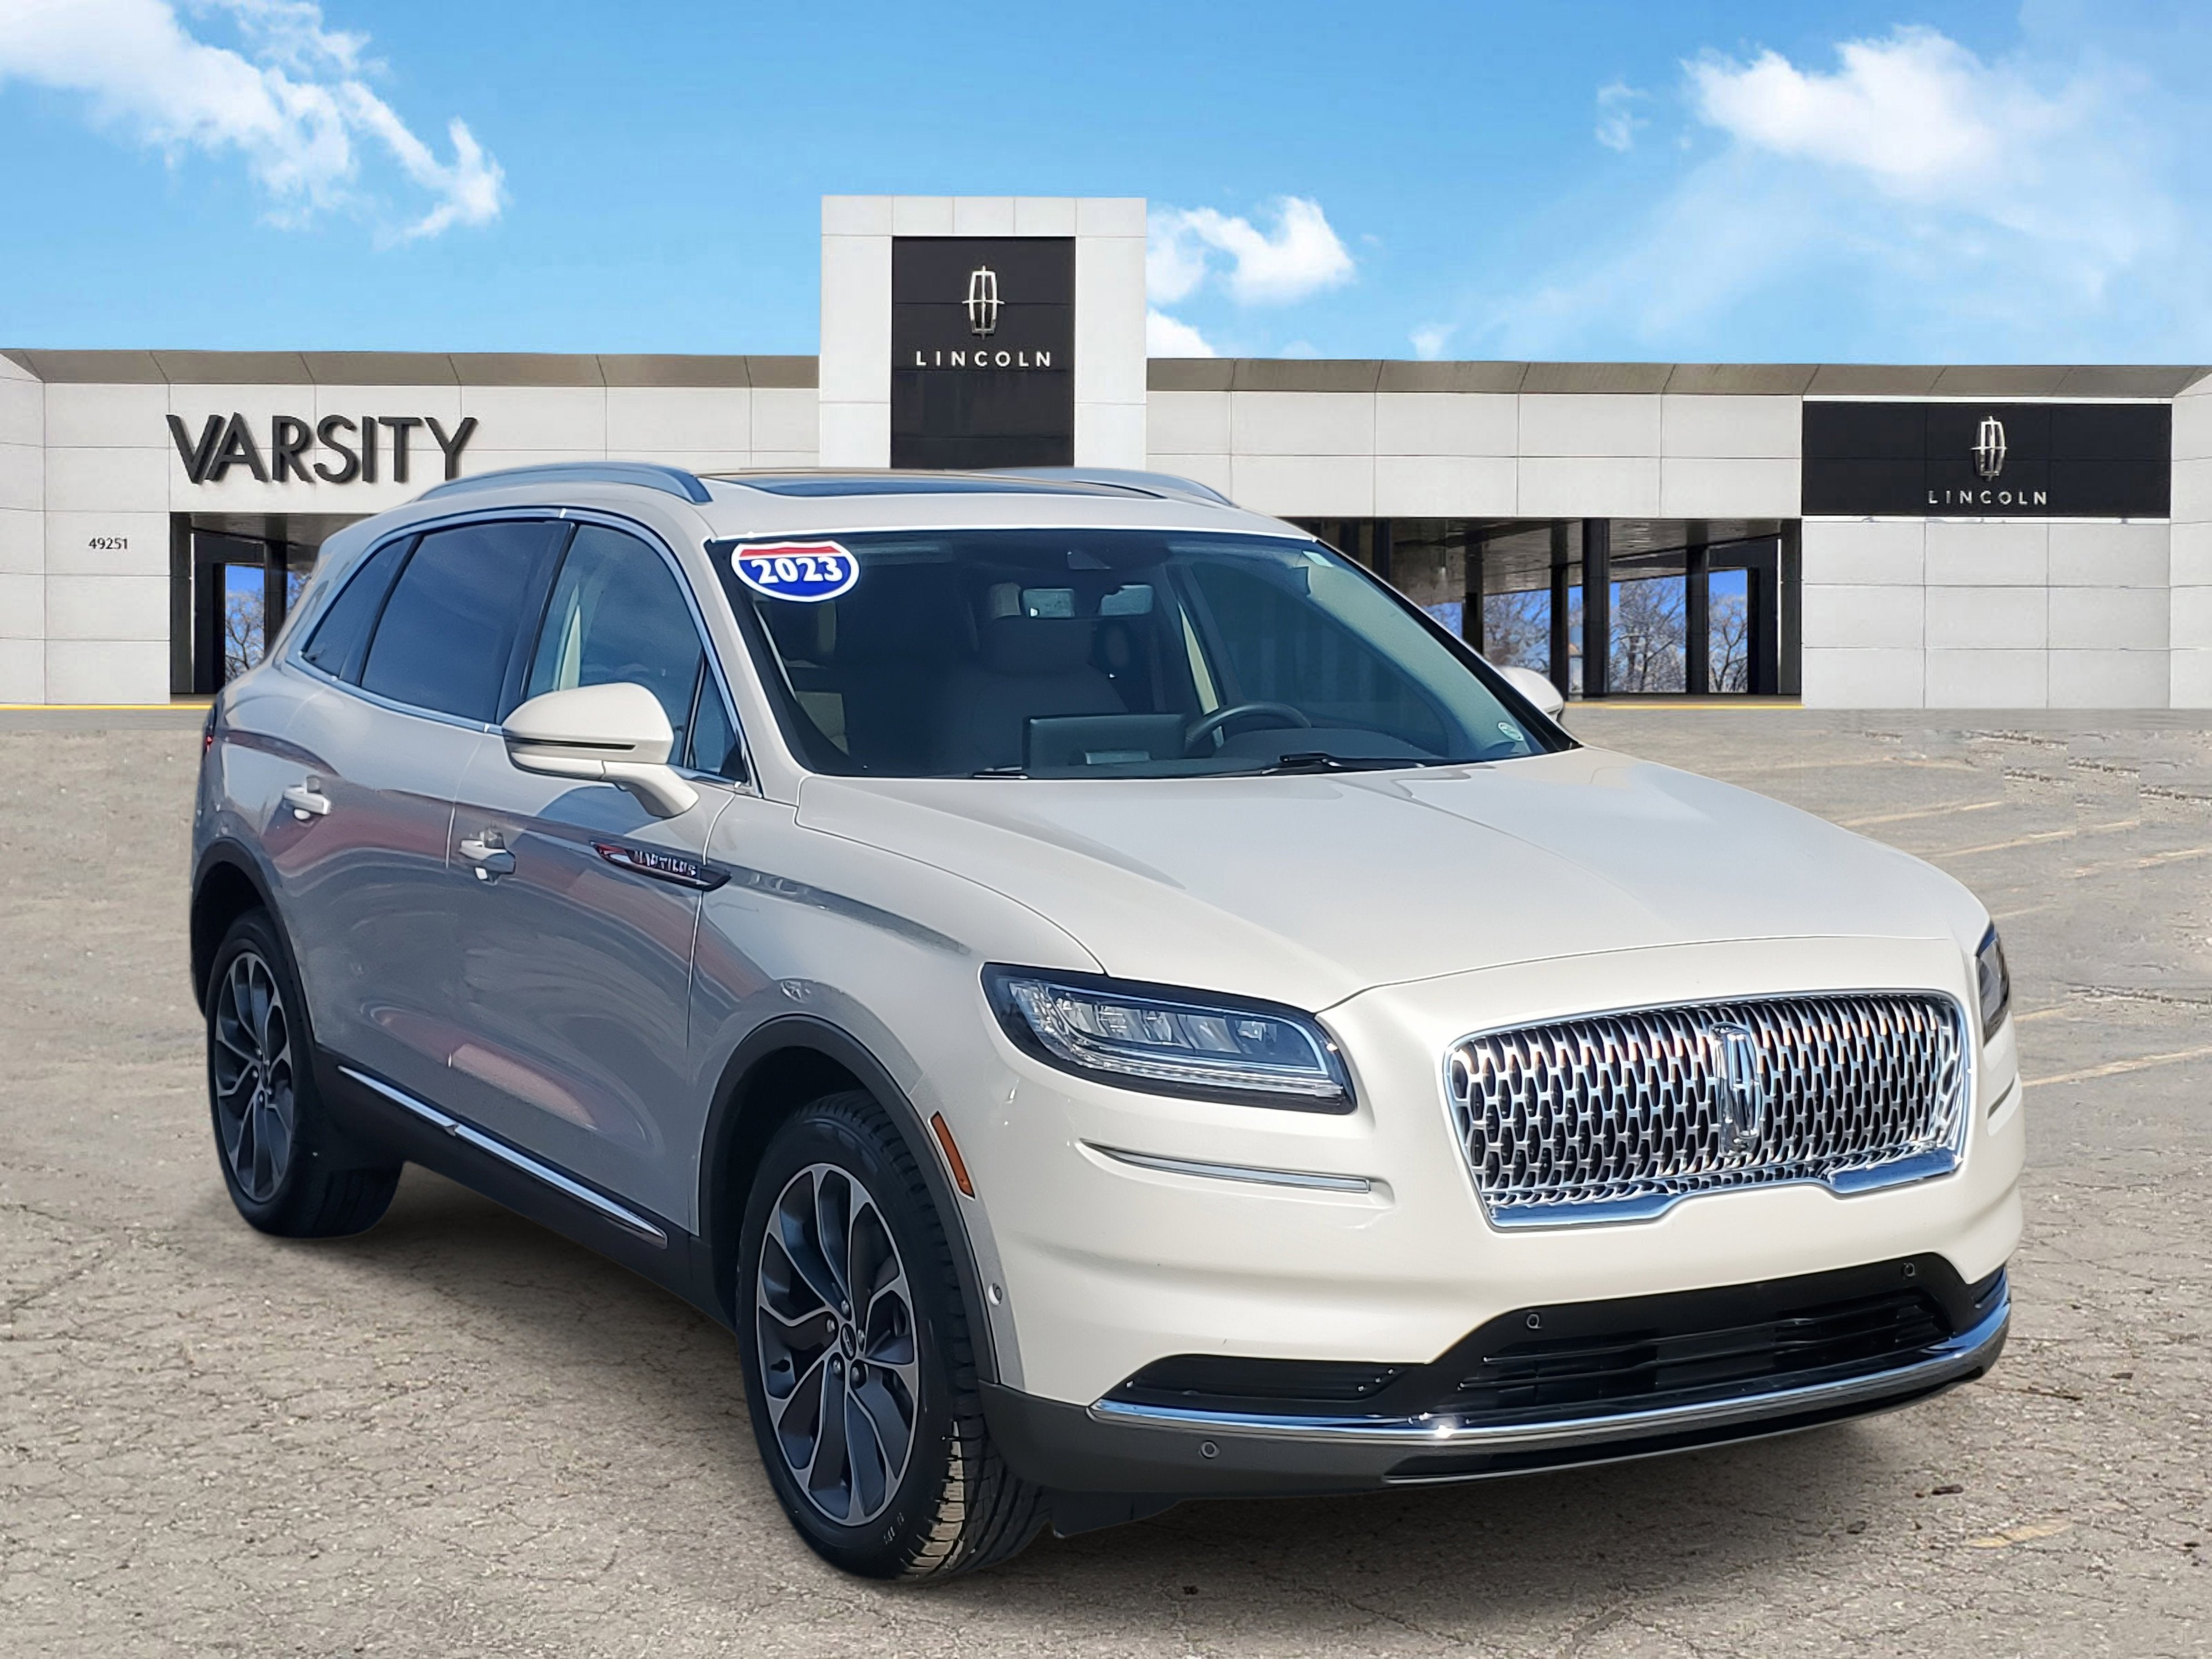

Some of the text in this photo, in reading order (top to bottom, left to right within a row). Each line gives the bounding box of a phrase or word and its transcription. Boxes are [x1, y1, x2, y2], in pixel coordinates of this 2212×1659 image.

[915, 351, 1051, 367] LINCOLN
[166, 412, 478, 484] VARSITY
[1928, 490, 2047, 505] LINCOLN
[88, 537, 128, 550] 49251
[750, 556, 843, 584] 2023
